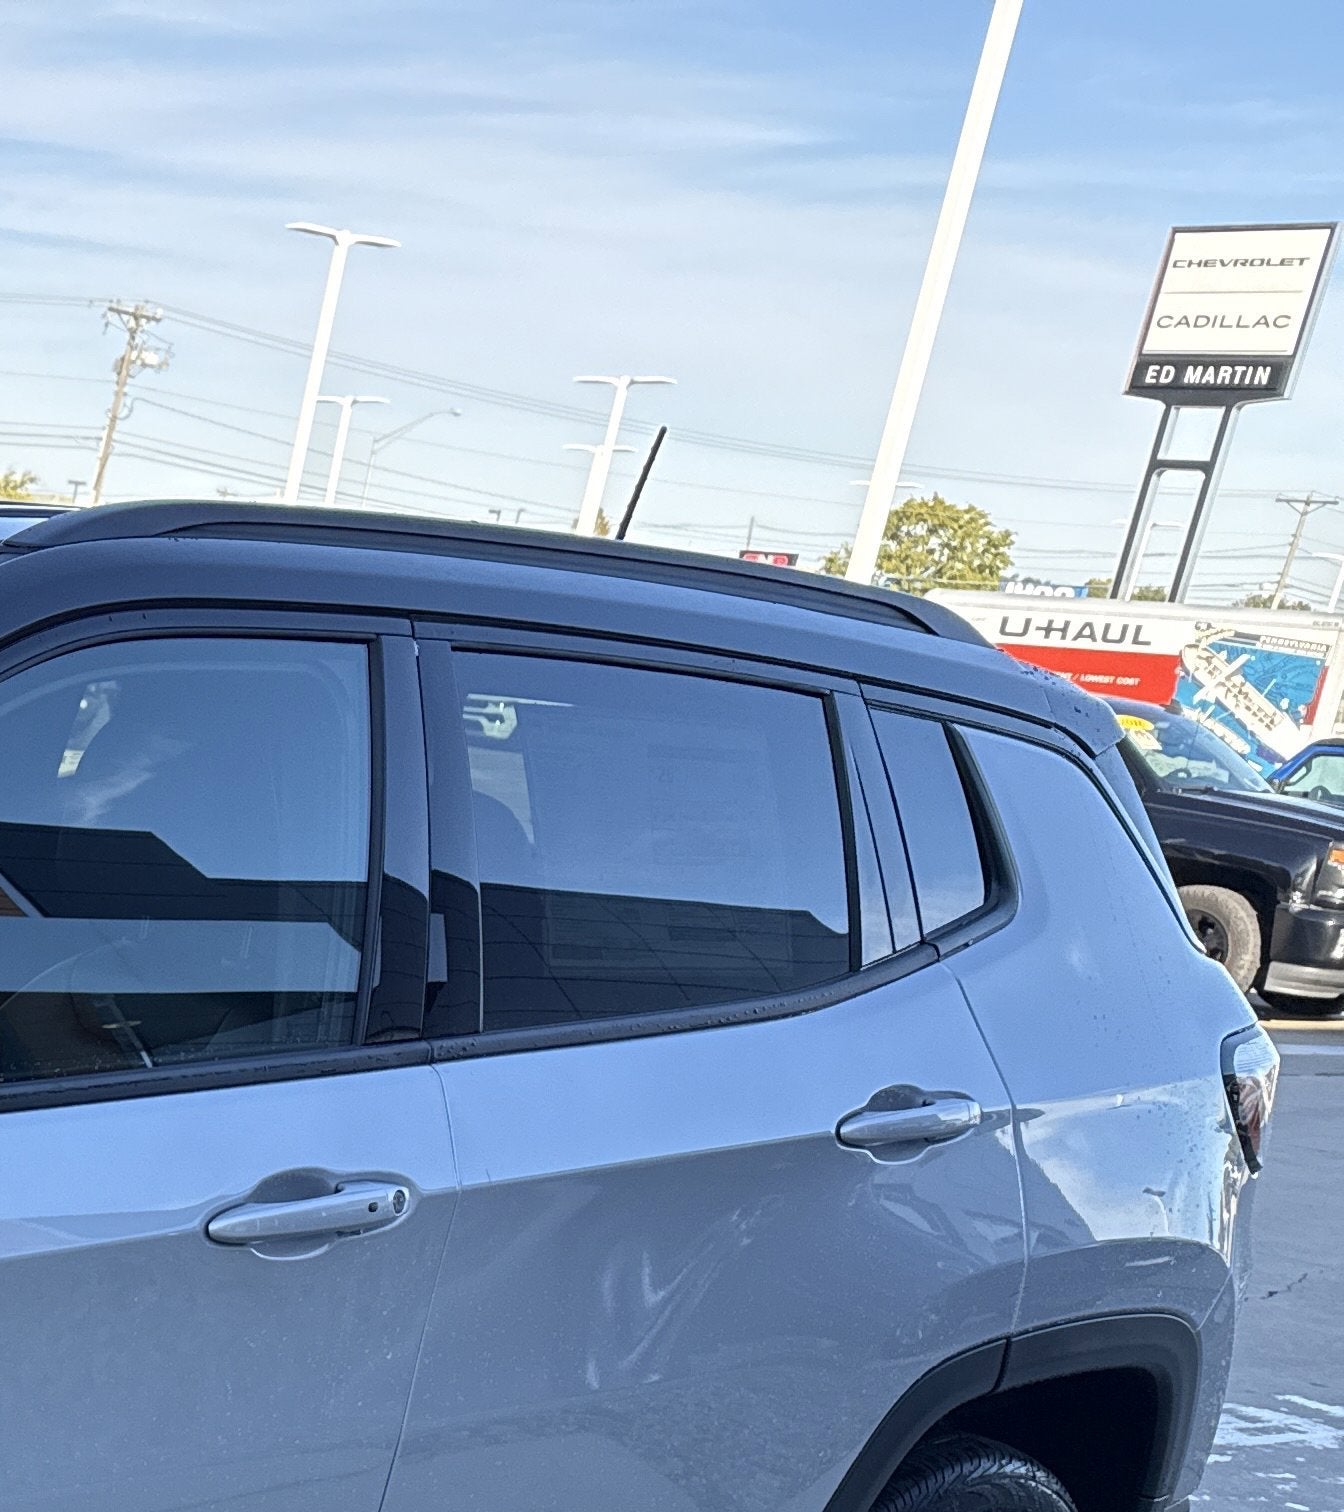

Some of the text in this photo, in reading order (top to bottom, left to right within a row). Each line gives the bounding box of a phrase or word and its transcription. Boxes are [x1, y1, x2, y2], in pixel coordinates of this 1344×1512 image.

[1172, 257, 1310, 268] CHEVROLET
[1156, 314, 1292, 329] CADILLAC
[1144, 364, 1272, 385] ED MARTIN
[998, 615, 1152, 646] U-HAUL
